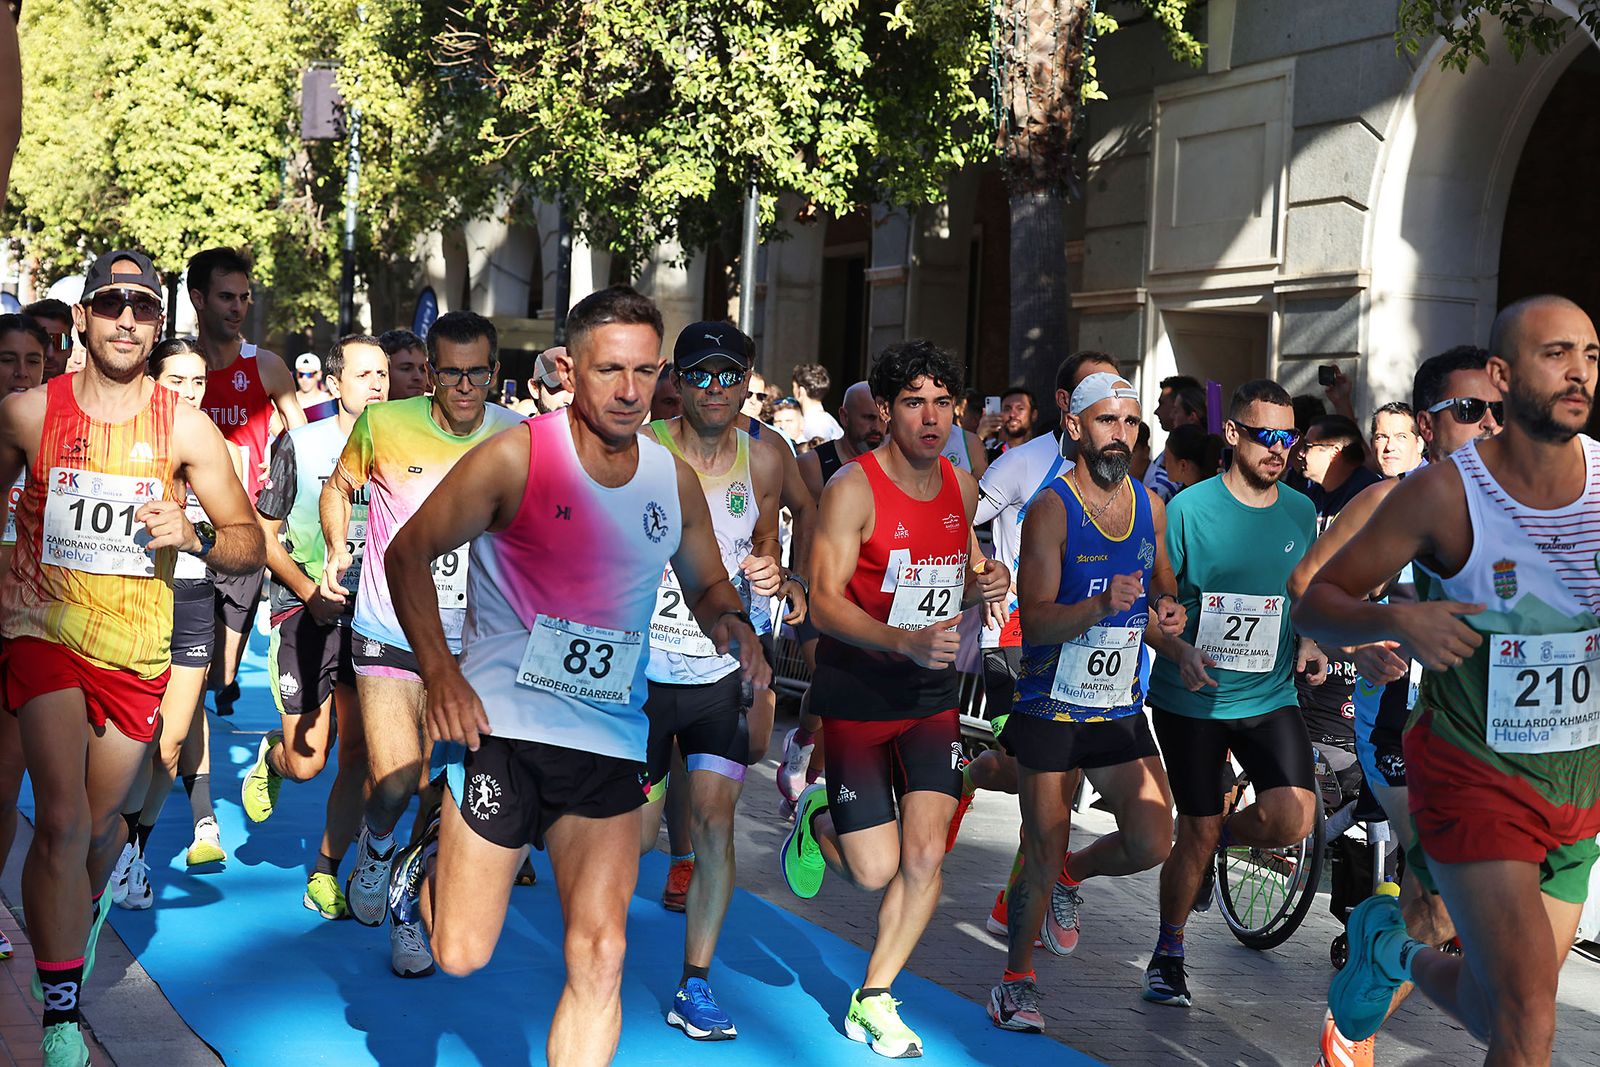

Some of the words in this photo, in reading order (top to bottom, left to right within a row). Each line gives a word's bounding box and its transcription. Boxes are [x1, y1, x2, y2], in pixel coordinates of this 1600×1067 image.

[69, 498, 135, 537] 101
[46, 534, 97, 551] ZAMORANO
[918, 588, 952, 617] 42
[1223, 615, 1260, 642] 27
[563, 638, 614, 680] 83
[1201, 644, 1249, 656] FERNANDEZ
[1087, 650, 1122, 677] 60
[523, 671, 577, 694] CORDERO
[579, 687, 624, 701] BARRERA
[1057, 683, 1096, 700] Huelva
[1081, 682, 1114, 691] MARTINS
[1514, 665, 1591, 708] 210
[1492, 715, 1557, 729] GALLARDO
[1494, 726, 1550, 743] Huelva
[471, 773, 502, 797] CORRALES
